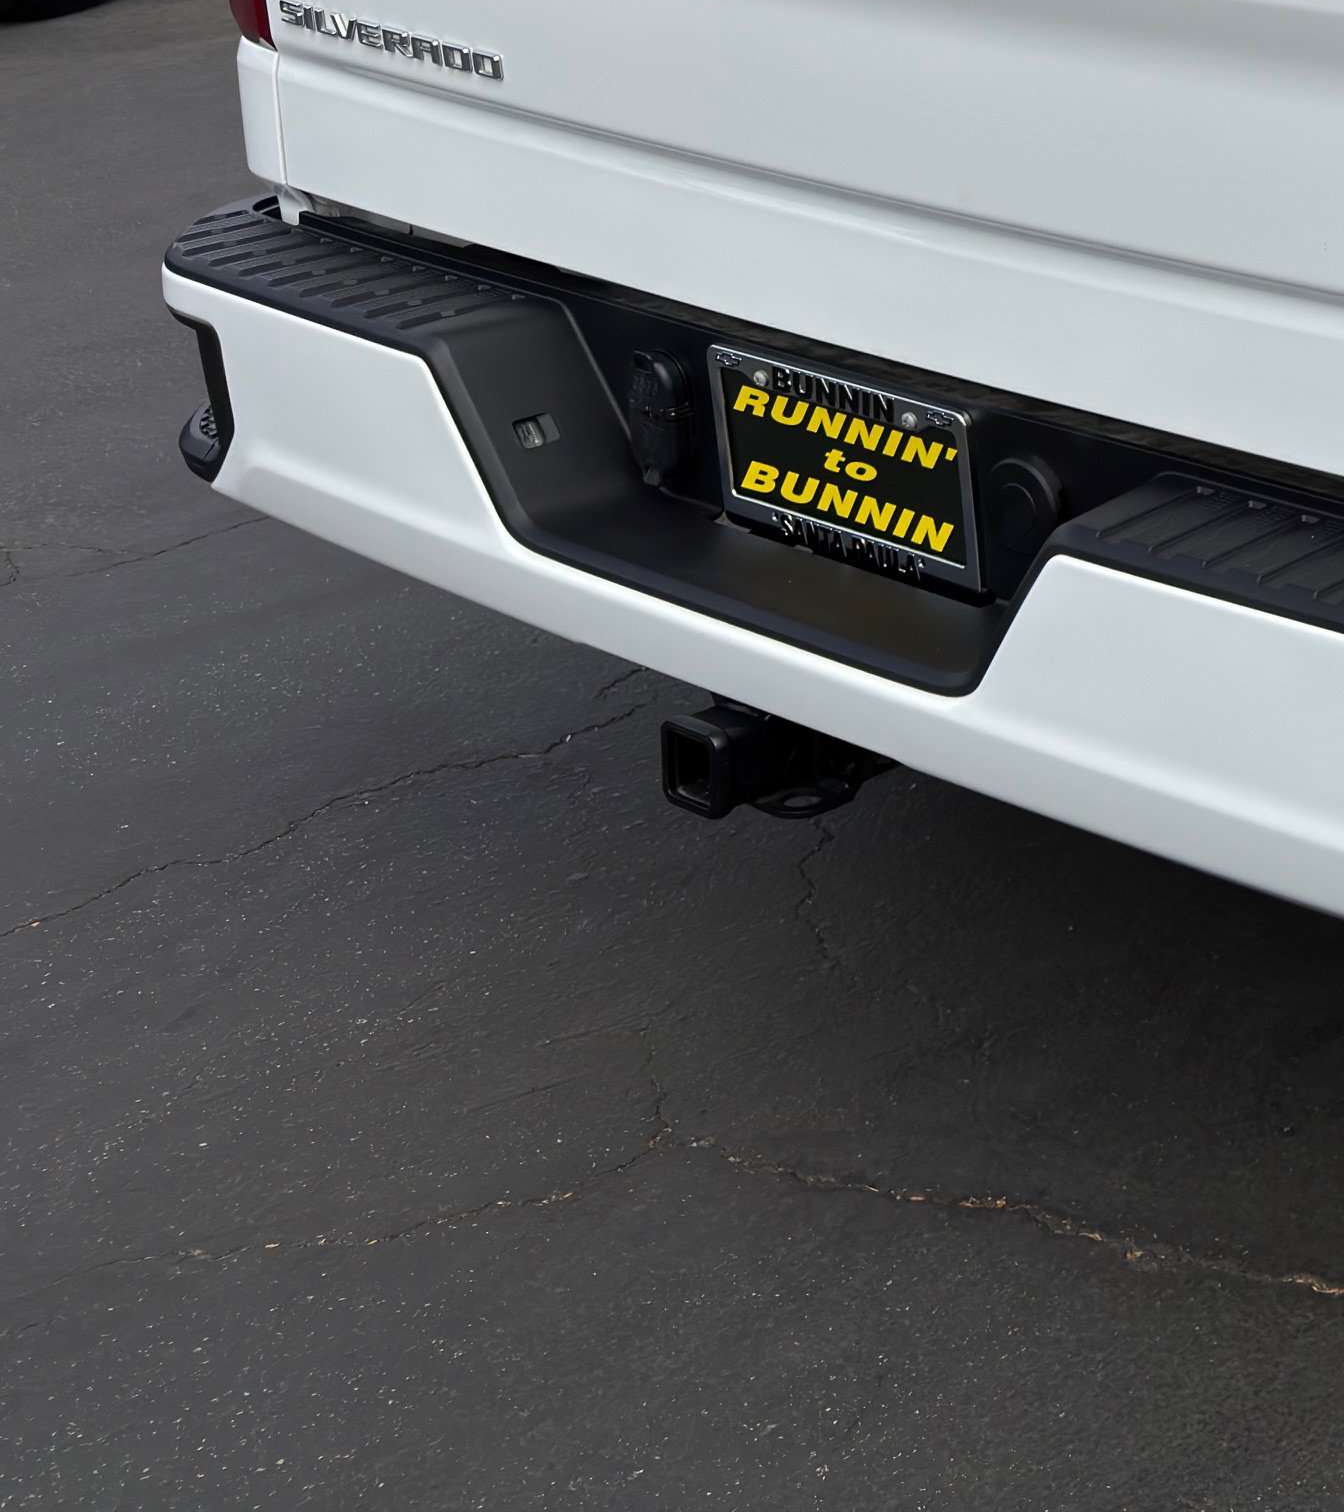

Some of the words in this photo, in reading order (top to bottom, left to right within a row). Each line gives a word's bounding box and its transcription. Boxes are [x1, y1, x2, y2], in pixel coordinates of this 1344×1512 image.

[732, 384, 958, 470] RUNNIN'
[772, 365, 895, 423] BUNNIN
[823, 448, 878, 482] to
[740, 460, 955, 553] BUNNIN
